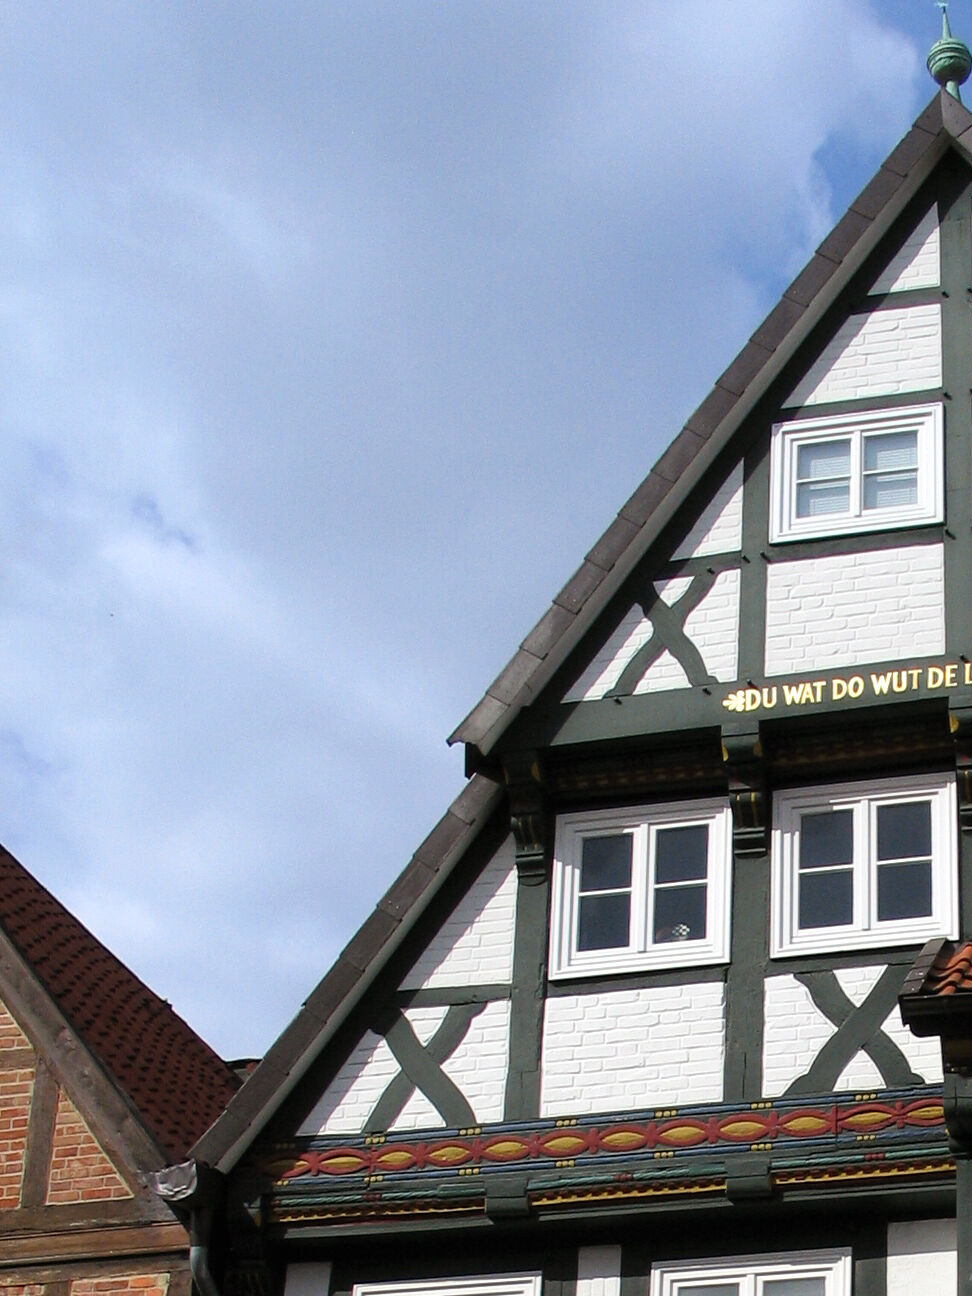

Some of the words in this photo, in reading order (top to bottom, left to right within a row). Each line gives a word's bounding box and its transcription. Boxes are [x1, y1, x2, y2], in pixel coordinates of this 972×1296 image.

[744, 686, 777, 711] DU
[783, 681, 826, 706] WAT
[832, 676, 864, 701] DO
[871, 669, 922, 696] WUT
[927, 664, 958, 690] DE
